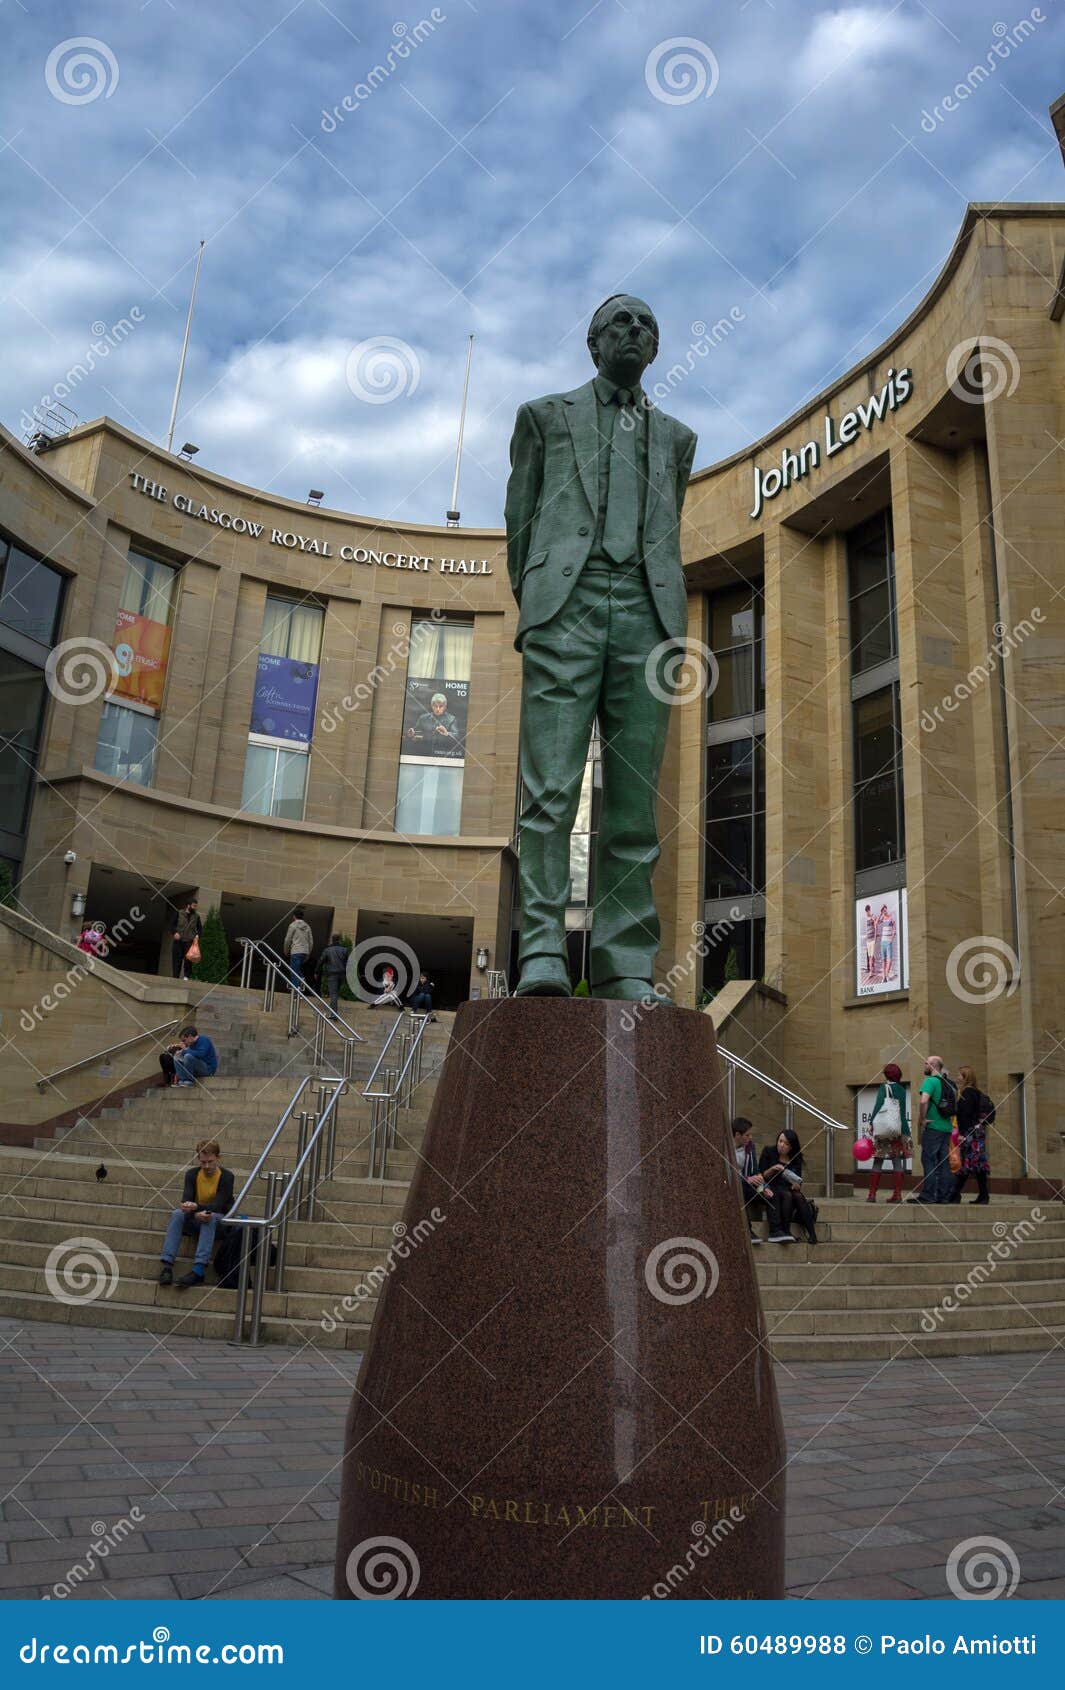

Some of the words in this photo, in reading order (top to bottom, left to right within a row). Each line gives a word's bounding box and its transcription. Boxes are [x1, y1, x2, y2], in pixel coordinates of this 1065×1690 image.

[750, 448, 820, 519] John
[825, 368, 912, 458] Lewis
[131, 472, 168, 503] THE
[172, 494, 264, 538] GLASGOW
[270, 528, 333, 557] ROYAL
[340, 545, 434, 572] CONCERT
[439, 558, 493, 576] HALL
[445, 682, 468, 690] HOME
[860, 986, 875, 995] BANK
[471, 1495, 656, 1528] PARLIAMENT
